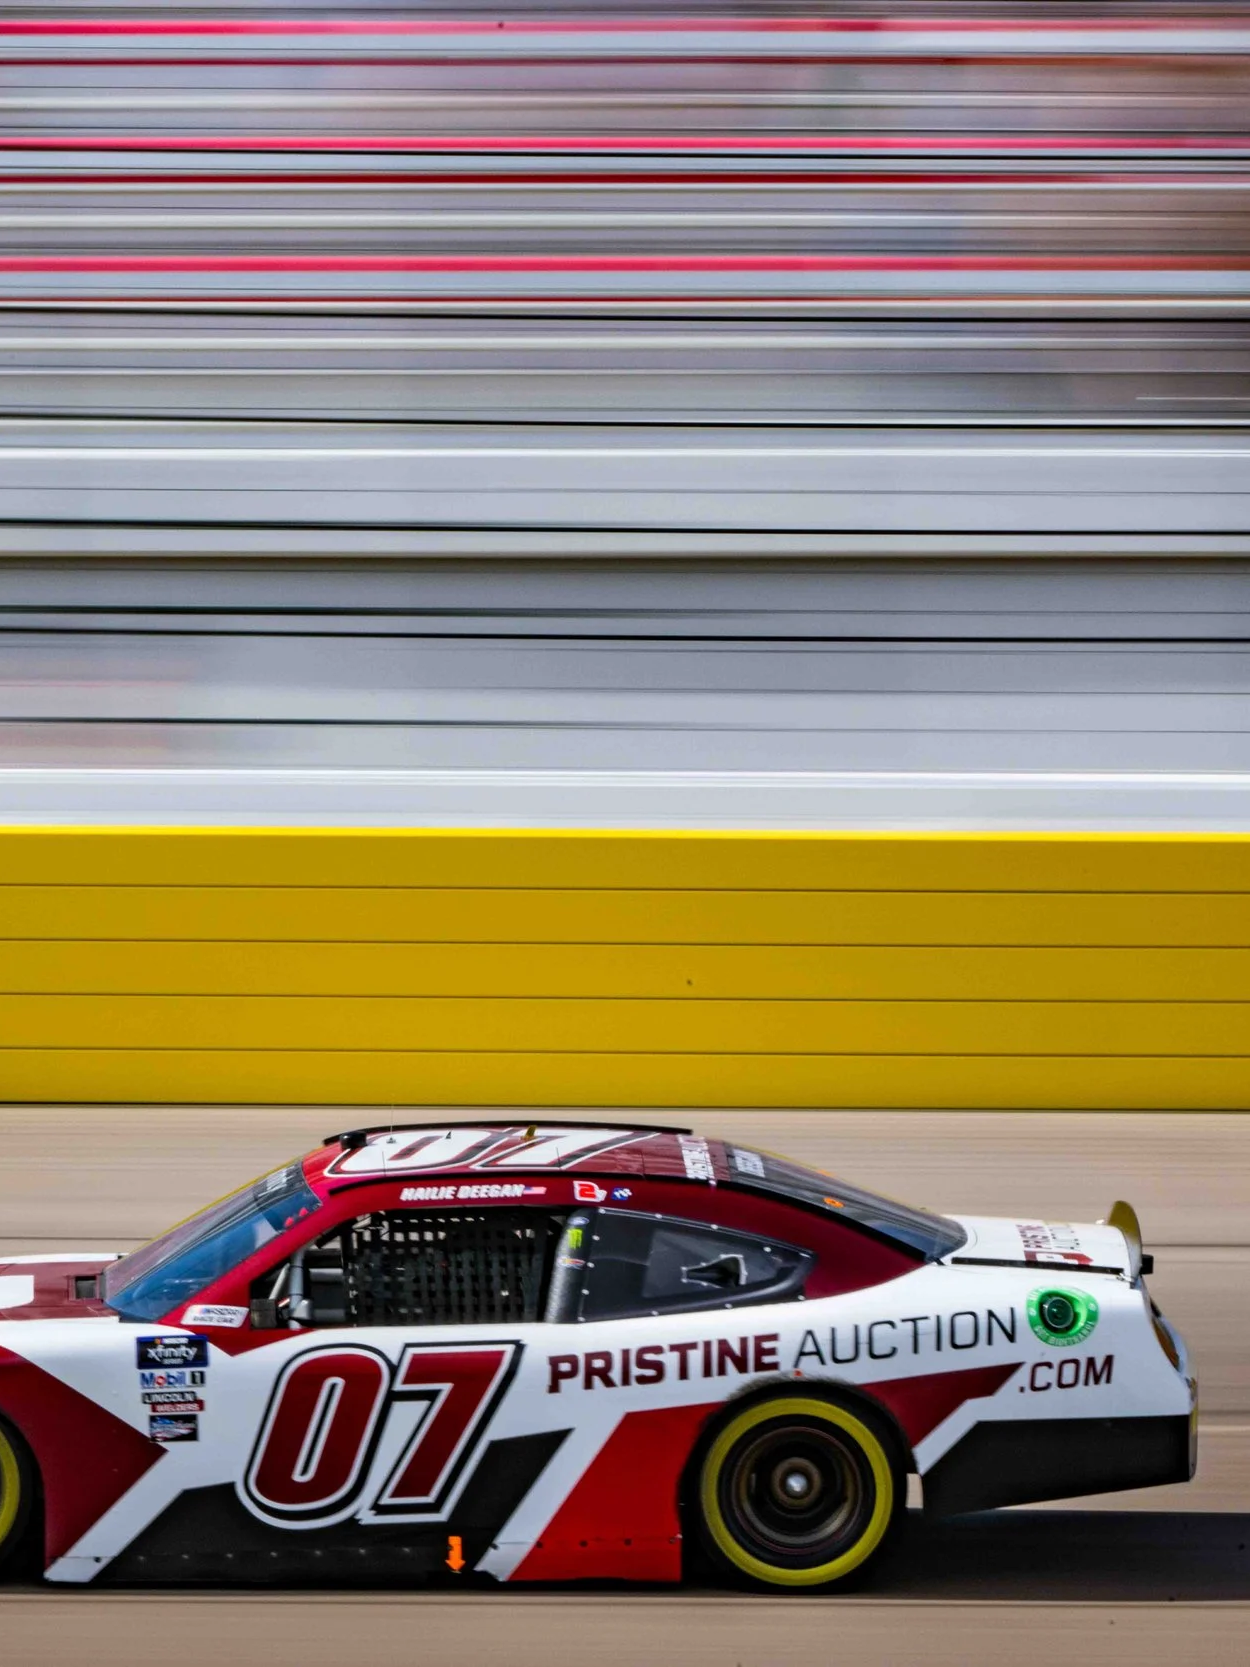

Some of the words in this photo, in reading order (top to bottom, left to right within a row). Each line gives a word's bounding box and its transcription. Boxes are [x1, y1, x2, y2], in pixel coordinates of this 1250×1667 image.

[324, 1128, 662, 1177] 07
[400, 1185, 457, 1201] HAILIE
[456, 1183, 525, 1199] DEEGAN
[147, 1344, 198, 1363] xfinity
[547, 1333, 780, 1393] PRISTINE
[793, 1307, 1017, 1368] AUCTION
[140, 1371, 186, 1387] Mobil
[1019, 1355, 1114, 1393] .COM
[145, 1392, 196, 1404] LINCOLN
[236, 1340, 526, 1529] 07
